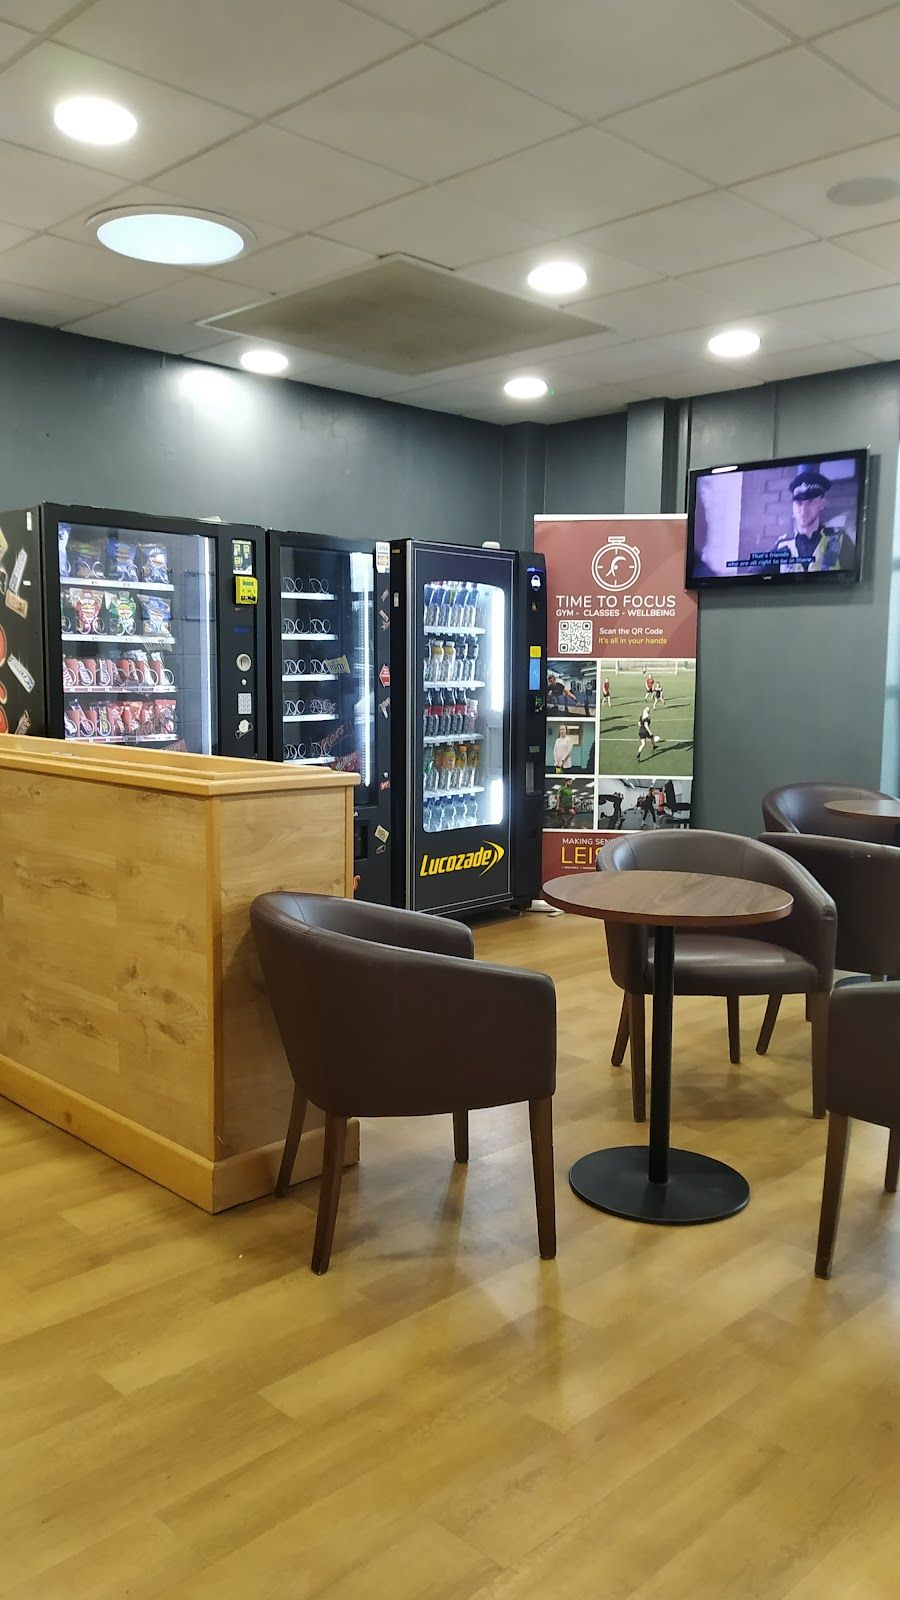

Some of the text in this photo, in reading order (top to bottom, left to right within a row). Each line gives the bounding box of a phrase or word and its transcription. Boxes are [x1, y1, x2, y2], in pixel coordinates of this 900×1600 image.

[556, 595, 676, 608] TIME TO FOCUS
[555, 609, 574, 617] GYM
[583, 609, 620, 617] CLASSES
[627, 609, 676, 617] WELLBEING
[599, 627, 664, 636] Scan the QR Code
[420, 847, 492, 876] Lucozade
